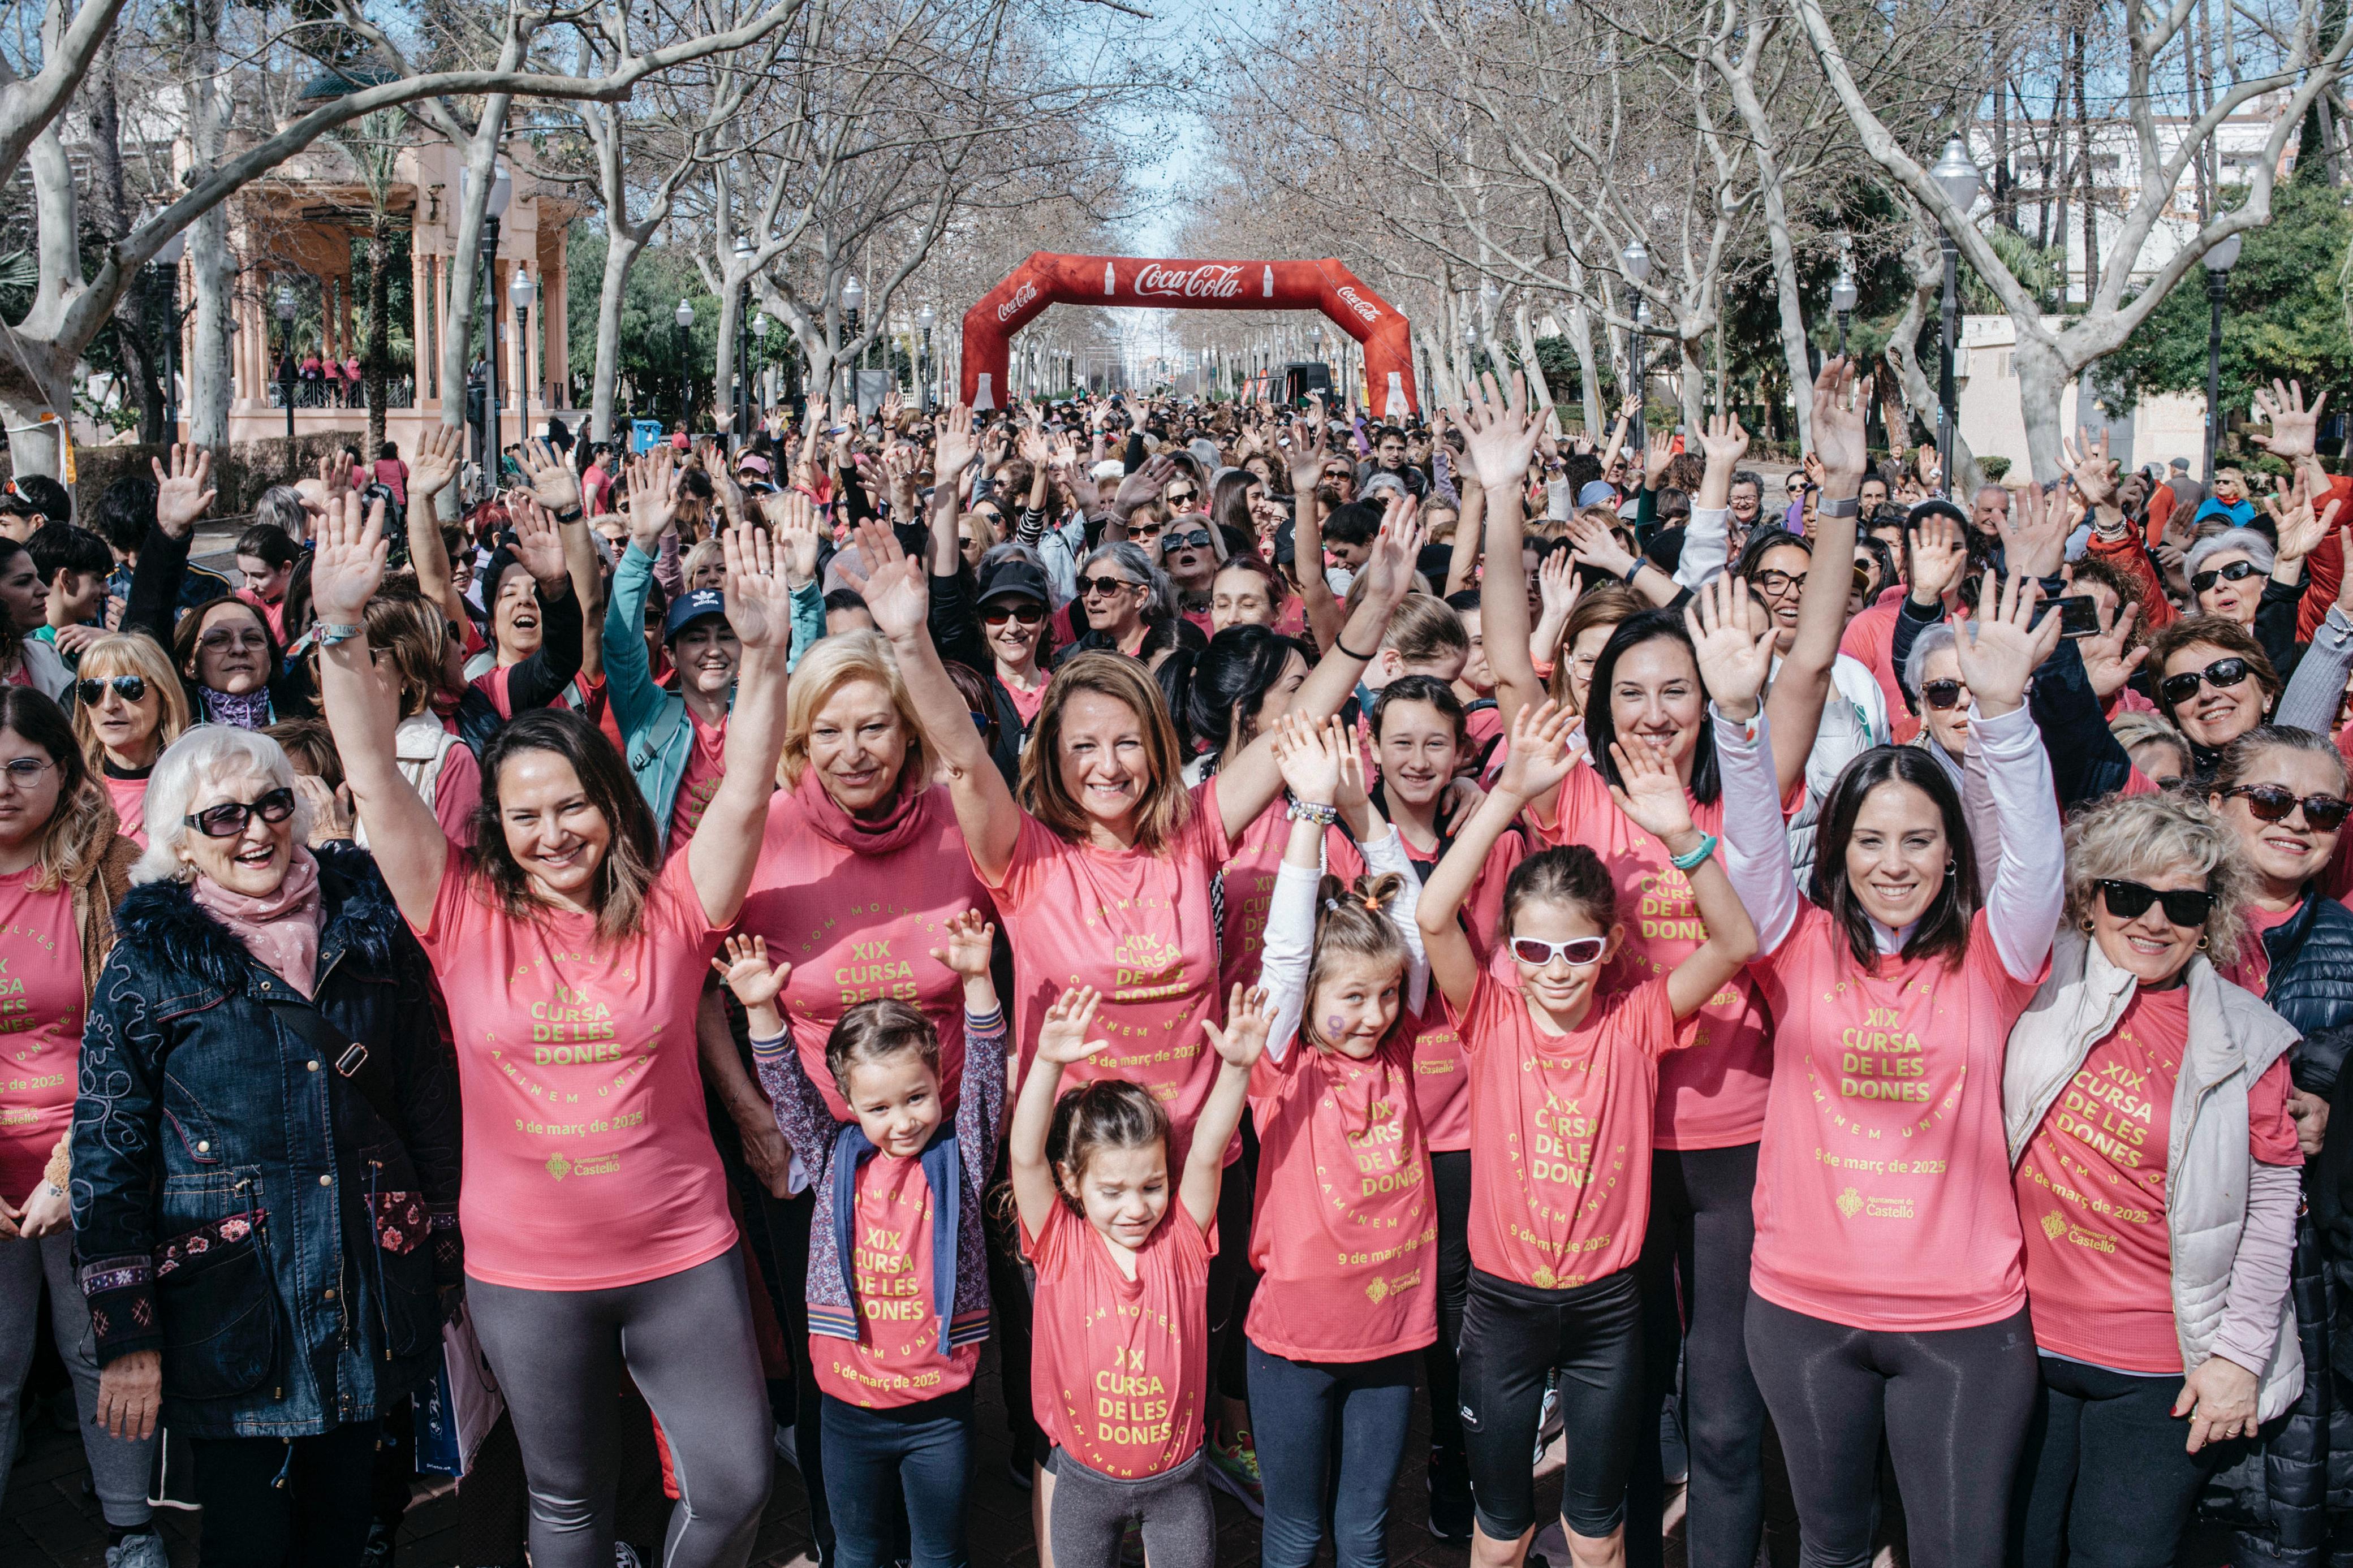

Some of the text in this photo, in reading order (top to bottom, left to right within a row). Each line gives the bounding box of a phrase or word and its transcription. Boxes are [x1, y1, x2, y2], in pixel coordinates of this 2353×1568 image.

[1134, 264, 1243, 297] Coca-Cola
[998, 279, 1037, 322] Coca-Cola
[1337, 286, 1383, 323] Coca-Cola
[706, 777, 721, 788] XI
[1641, 876, 1696, 900] CURS
[1642, 898, 1704, 917] DE LE
[802, 918, 836, 953] SOM
[1124, 932, 1161, 951] XIX
[1642, 920, 1711, 940] DONE
[851, 940, 891, 962] XIX
[1114, 943, 1183, 969] CURSA
[835, 961, 914, 985] CURSA
[1115, 962, 1186, 987] DE LES
[553, 982, 590, 1005] XIX
[531, 1001, 611, 1022] CURSA
[1863, 1007, 1901, 1030] XIX
[16, 1005, 76, 1061] UNIDES
[533, 1021, 615, 1042] DE LES
[1416, 1035, 1433, 1046] arç
[1436, 1033, 1449, 1043] de
[1842, 1028, 1922, 1053] CURSA
[486, 1025, 662, 1104] CAMINEM UNIDES
[535, 1043, 622, 1065] DONES
[1088, 1054, 1097, 1065] 9
[1100, 1052, 1117, 1068] de
[1119, 1051, 1152, 1068] març
[1154, 1049, 1170, 1063] de
[1523, 1056, 1539, 1073] OM
[1843, 1052, 1924, 1077] DE LES
[1420, 1063, 1454, 1074] Castelló
[2100, 1060, 2145, 1092] XIX
[8, 1079, 27, 1091] de
[31, 1074, 64, 1089] 2025
[1841, 1078, 1930, 1102] DONES
[1545, 1090, 1582, 1115] XIX
[2072, 1070, 2152, 1124] CURSA
[0, 1113, 38, 1126] astelló
[1364, 1099, 1394, 1121] IX
[2065, 1091, 2148, 1146] DE LES
[515, 1111, 643, 1137] 9 de març de 2025
[1348, 1116, 1407, 1150] CURS
[1535, 1134, 1591, 1163] DE LE
[2056, 1112, 2143, 1168] DONES
[574, 1154, 609, 1165] Ajuntament
[574, 1159, 620, 1176] Castelló
[1358, 1152, 1386, 1173] DE
[1815, 1147, 1946, 1175] 9 de març de 2025
[1361, 1161, 1424, 1197] DONES
[1532, 1159, 1595, 1189] DONS
[1316, 1165, 1398, 1228] CAMINEM
[1867, 1195, 1904, 1206] Ajuntament
[2024, 1165, 2149, 1224] 9 de març de 2025
[1866, 1204, 1914, 1219] Castelló
[864, 1227, 901, 1251] XIX
[1510, 1224, 1518, 1236] 9
[1520, 1228, 1537, 1245] de
[1564, 1237, 1580, 1253] de
[1583, 1234, 1610, 1251] 2025
[2068, 1232, 2116, 1254] Castelló
[2070, 1223, 2118, 1242] Ajuntament de
[852, 1247, 915, 1275] CURSA
[1338, 1252, 1347, 1265] 9
[1350, 1251, 1368, 1265] de
[1371, 1246, 1403, 1263] març
[1404, 1238, 1417, 1251] de
[882, 1277, 919, 1297] LES
[1389, 1275, 1420, 1297] Castelló
[833, 1361, 941, 1392] 9 de març de 2025
[1096, 1370, 1165, 1397] CURSA
[1098, 1397, 1167, 1422] DE LES
[1063, 1389, 1132, 1476] CAMINEM
[1098, 1422, 1172, 1445] DONES
